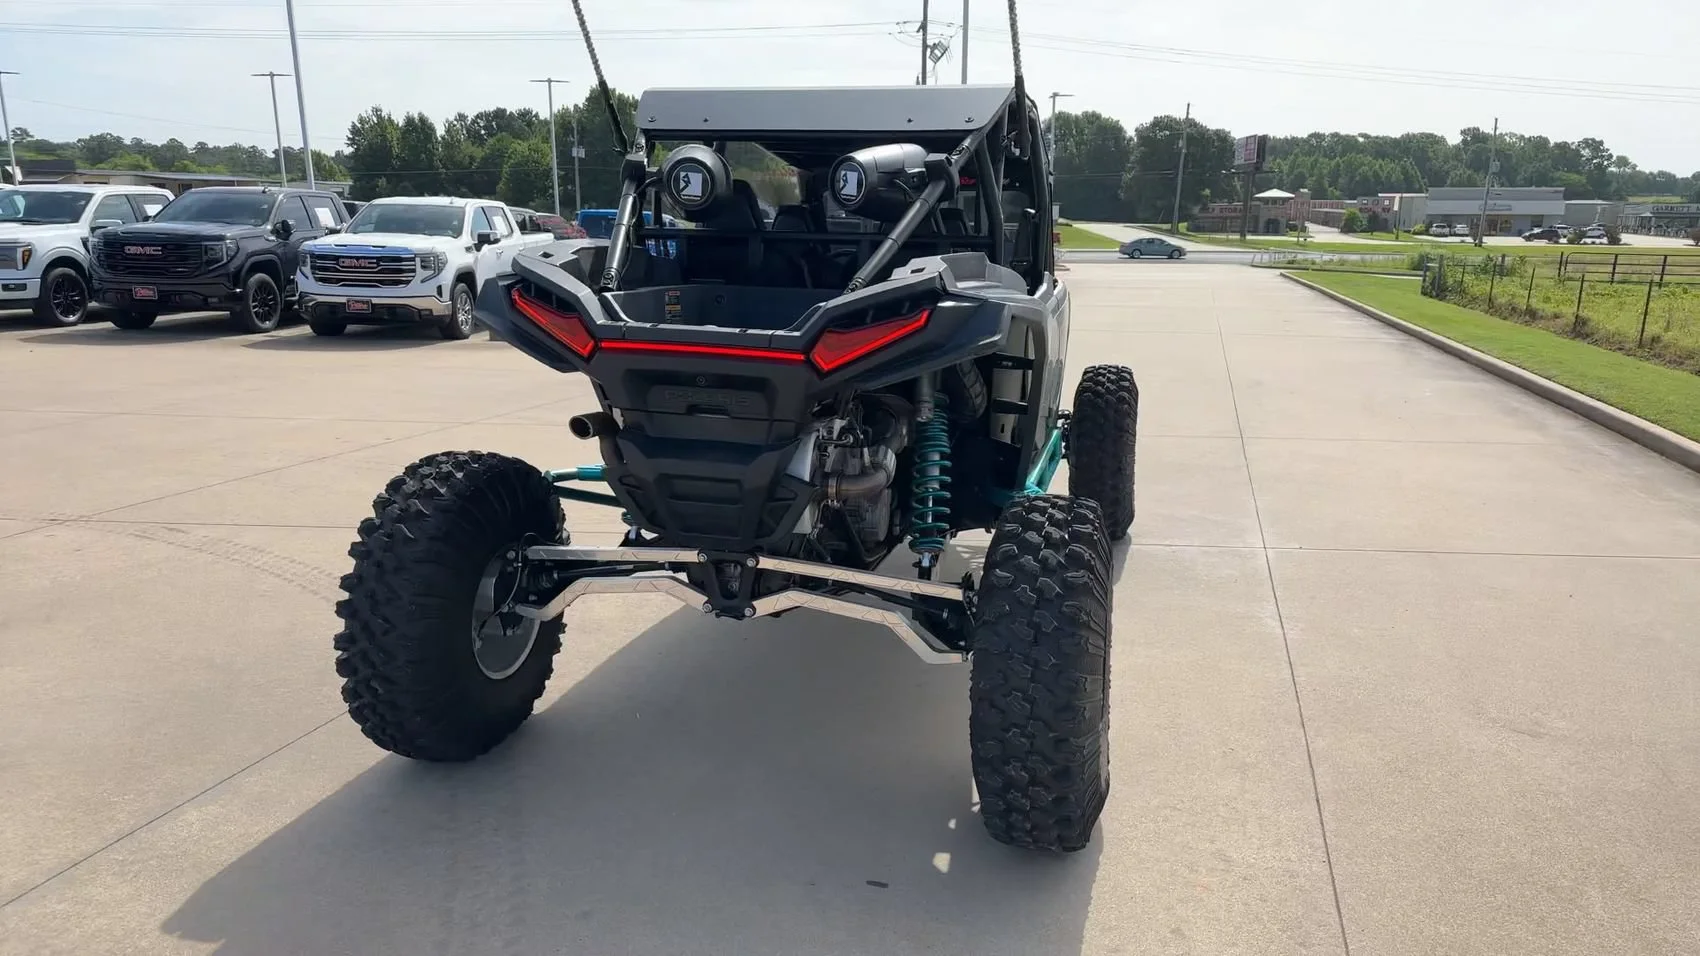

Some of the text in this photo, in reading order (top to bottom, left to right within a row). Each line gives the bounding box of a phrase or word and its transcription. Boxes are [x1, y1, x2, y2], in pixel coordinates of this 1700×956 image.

[1219, 206, 1253, 214] STORAE
[124, 245, 162, 255] GMC
[338, 258, 377, 267] GMC
